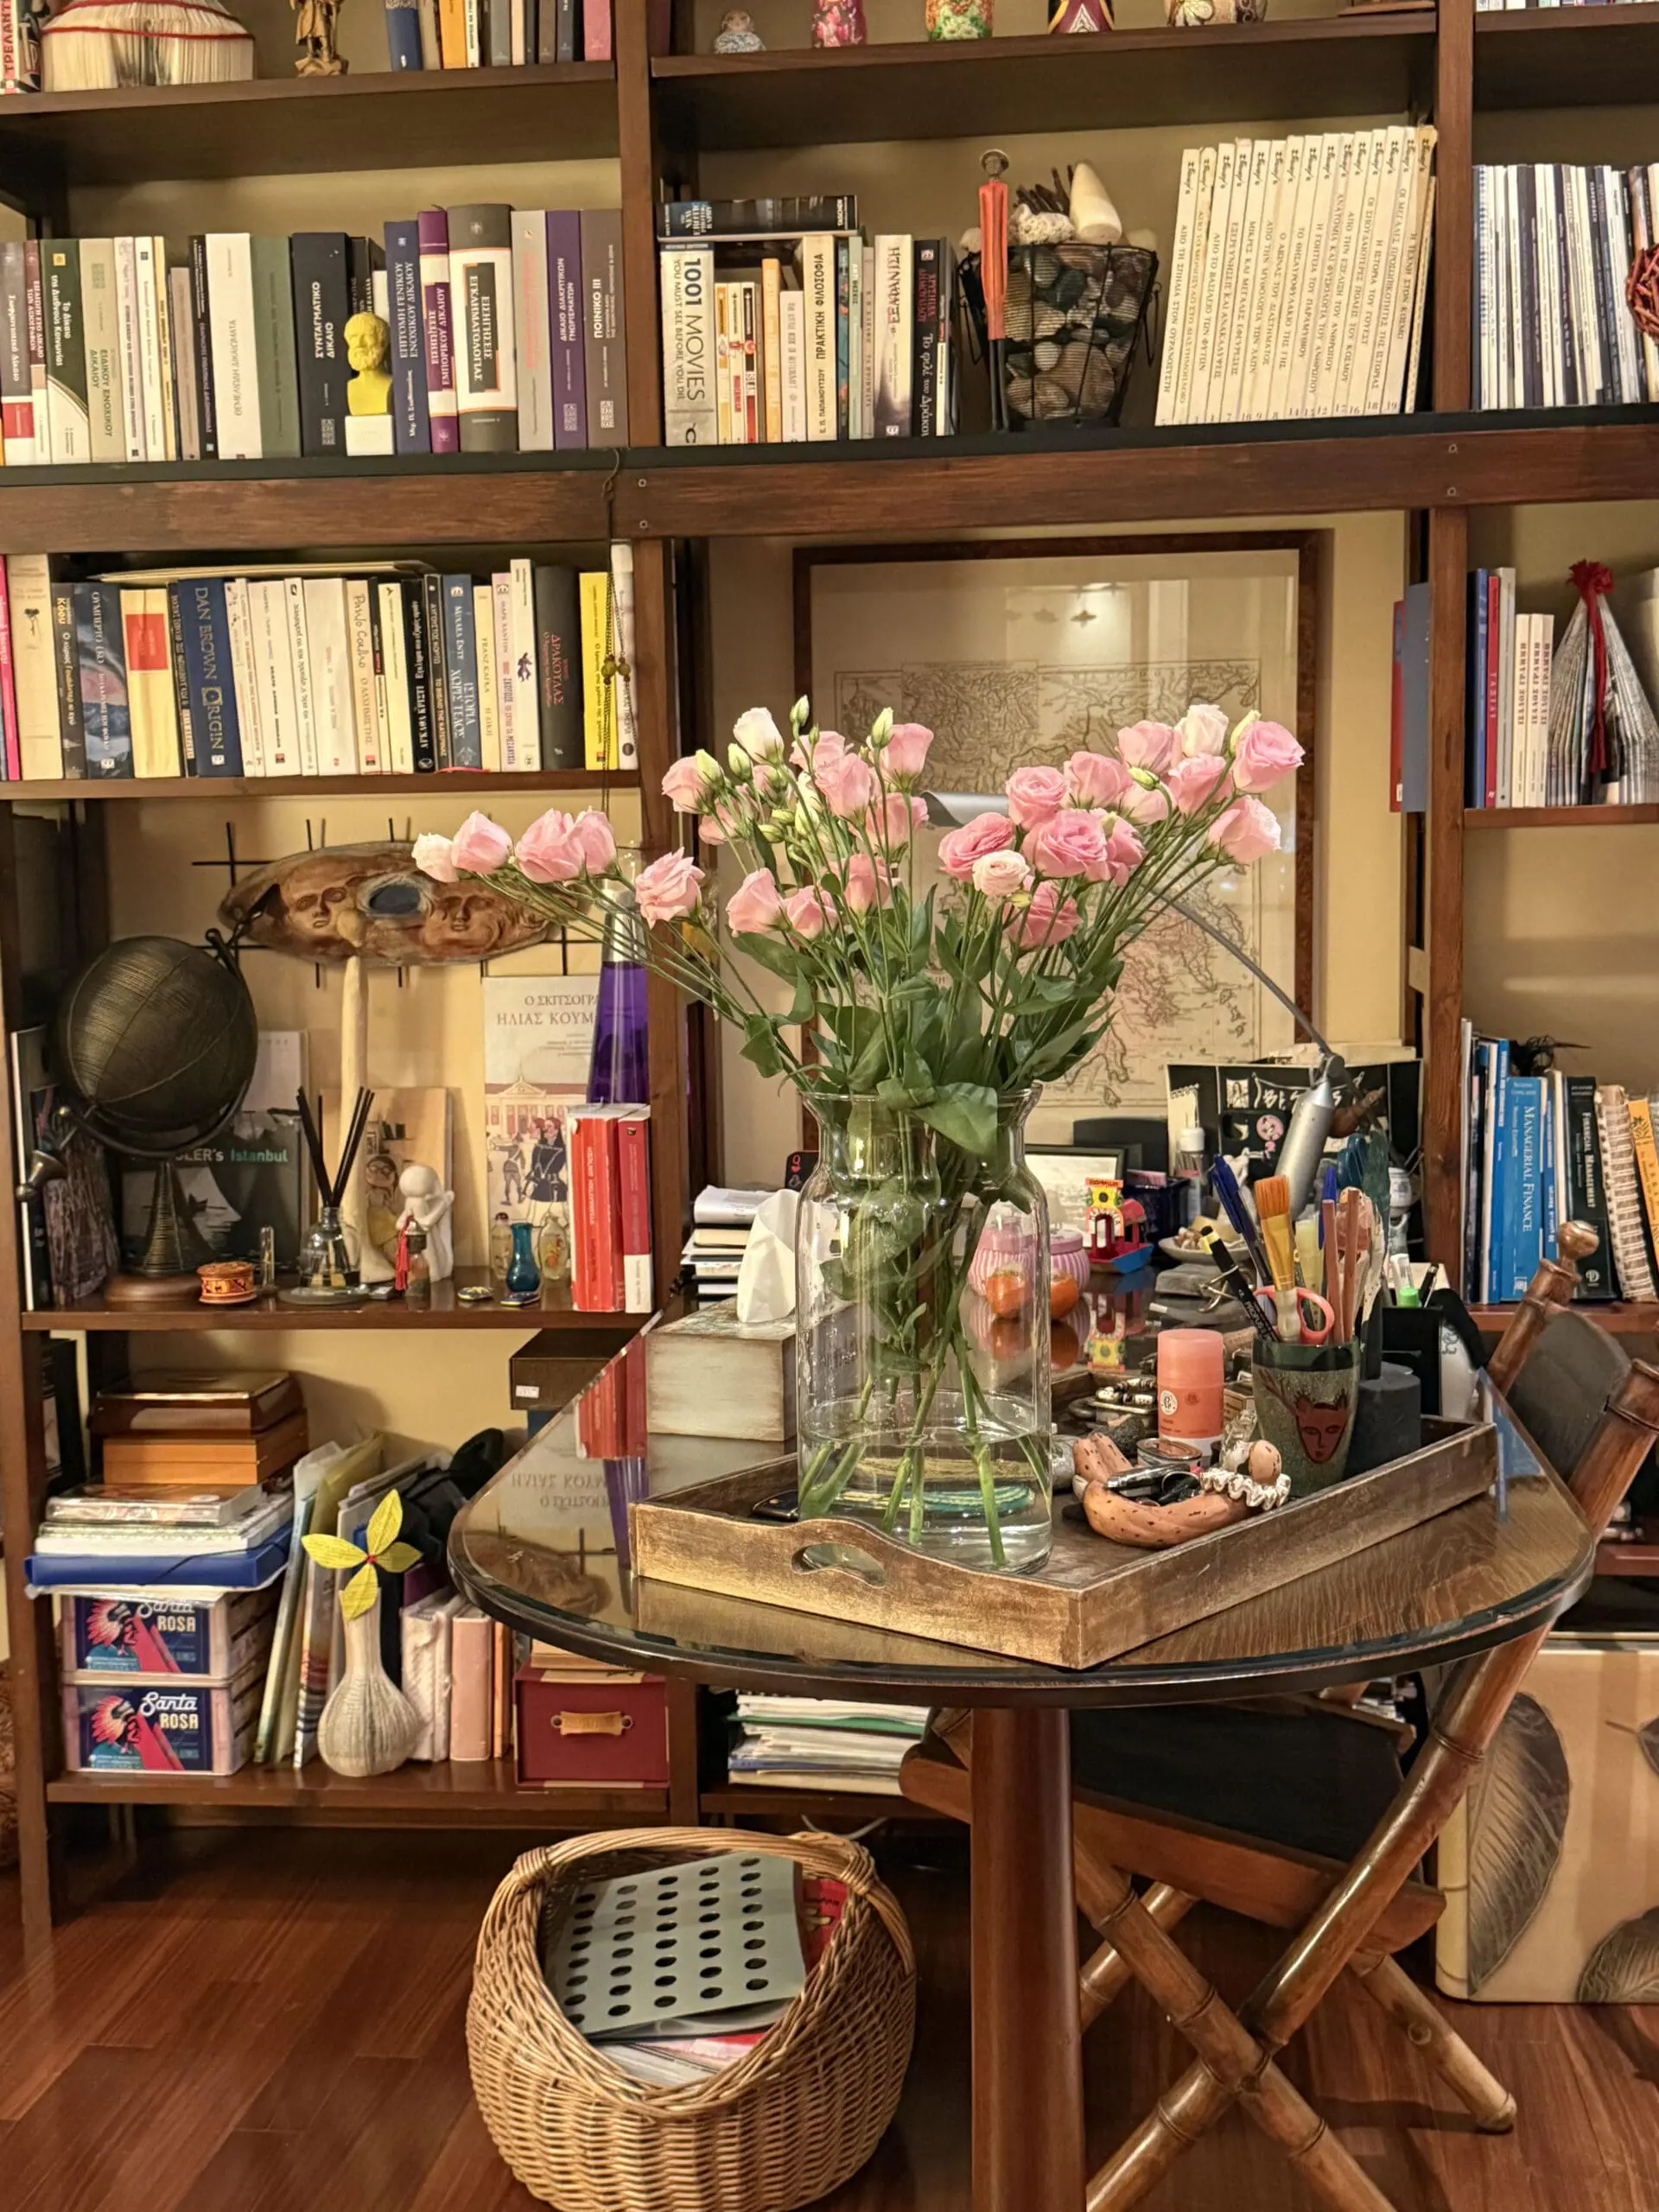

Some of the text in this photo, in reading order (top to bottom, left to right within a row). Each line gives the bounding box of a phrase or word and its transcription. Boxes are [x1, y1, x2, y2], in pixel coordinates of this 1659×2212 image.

[1, 0, 15, 73] ΤΡΕΛΑΝΤ
[1331, 194, 1343, 241] ΑΝΑΤΟΜΙΑ
[1345, 212, 1355, 232] ΑΠΟ
[1392, 200, 1404, 244] ΜΕΓΑΛΕΣ
[1246, 221, 1255, 254] ΜΙΚΡΕΣ
[1343, 236, 1351, 254] ΤΗΝ
[814, 253, 823, 306] ΦΙΛΟΣΟΦΙΑ
[1370, 251, 1382, 284] ΙΣΤΟΡΙΑ
[1406, 245, 1415, 275] ΤΕΧΝΗ
[557, 257, 568, 341] ΔΙΚΑΙΟ ΔΙΑΚΡΙΤΙΚΩΝ
[674, 283, 683, 307] MUST
[887, 246, 900, 324] ΕΞΑΦΑΝΙΣΗ
[1174, 264, 1183, 296] ΣΠΗΛΙΑ
[1205, 272, 1216, 313] ΒΑΣΙΛΕΙΟ
[1238, 278, 1249, 321] ΜΕΓΑΛΕΣ
[1255, 268, 1268, 321] ΜΥΘΟΛΟΓΙΑ
[1307, 277, 1316, 295] ΤΟΥ
[1367, 289, 1376, 307] ΤΟΥ
[1402, 278, 1411, 301] ΣΤΟΝ
[50, 275, 64, 365] της Διεθνούς Κοινωνίας
[62, 302, 72, 339] Το Δίκαιο
[312, 282, 323, 359] ΣΥΝΤΑΓΜΑΤΙΚΟ
[395, 263, 408, 359] ΕΠΙΤΟΜΗ ΓΕΝΙΚΟΥ
[405, 262, 418, 358] ΕΝΟΧΙΚΟΥ ΔΙΚΑΙΟΥ
[567, 282, 575, 341] ΓΝΩΡΙΣΜΑΤΩΝ
[593, 291, 603, 339] ΠΟΙΝΙΚΟ
[1171, 302, 1179, 324] ΣΤΟΝ
[1333, 301, 1342, 317] ΤΟΥ
[1351, 286, 1362, 319] ΠΟΛΕΙΣ
[325, 322, 335, 359] ΔΙΚΑΙΟ
[429, 310, 439, 365] ΕΙΣΗΓΗΣΕΙΣ
[436, 288, 450, 385] ΕΜΠΟΡΙΚΟΥ ΔΙΚΑΙΟΥ
[471, 276, 482, 382] ΕΓΚΛΗΜΑΤΟΛΟΓΙΑΣ
[482, 296, 492, 359] ΕΙΣΗΓΗΣΕΙΣ
[684, 258, 705, 400] 1001 MOVIES
[815, 312, 826, 359] ΠΡΑΚΤΙΚΗ
[922, 334, 933, 348] Το
[1203, 316, 1211, 335] ΤΩΝ
[1253, 327, 1262, 345] ΤΩΝ
[1262, 303, 1277, 365] ΔΙΑΣΤΗΜΑΤΟΣ
[1282, 331, 1291, 346] ΤΗΣ
[1299, 298, 1313, 359] ΠΑΡΑΜΥΘΙΟΥ
[1317, 323, 1325, 340] ΤΟΥ
[1362, 312, 1372, 346] ΓΟΥΕΣΤ
[920, 352, 934, 376] φιλί
[1164, 328, 1177, 392] ΟΥΡΑΝΟΞΥΣΤΗ
[1199, 339, 1209, 372] ΦΥΤΩΝ
[1250, 348, 1259, 374] ΛΑΩΝ
[1280, 351, 1288, 370] ΓΗΣ
[1325, 321, 1338, 372] ΑΝΘΡΩΠΟΥ
[1341, 345, 1353, 383] ΚΟΣΜΟΥ
[11, 355, 21, 381] Δίκαιο
[90, 349, 99, 388] ΔΙΚΑΙΟΥ
[229, 320, 243, 416] ΘΕΜΕΛΙΩΔΗ ΔΙΚΑΙΩΜΑΤΑ
[1310, 346, 1322, 395] ΑΝΘΡΩΠΟΥ
[1371, 351, 1382, 390] ΙΣΤΟΡΙΑΣ
[99, 349, 112, 436] ΕΙΔΙΚΟΥ ΕΝΟΧΙΚΟΥ
[817, 369, 826, 416] ΠΑΠΑΝΟΥΤΣΟΥ
[57, 597, 67, 625] Κόου
[91, 592, 104, 664] ΟΥΜΠΕΡΤΟ ΕΚΟ
[454, 607, 463, 638] ΜΙΧΑΕΛ
[353, 594, 368, 669] Paulo Coelho
[63, 641, 73, 664] κύριος
[194, 588, 224, 749] DAN BROWN ORIGIN
[550, 634, 563, 705] ΔΡΑΚΟΥΛΑΣ
[1541, 643, 1550, 685] ΓΡΑΜΜΗ
[361, 686, 372, 745] ΑΛΧΗΜΙΣΤΗΣ
[416, 686, 429, 749] ΑΓΚΑΘΑ ΚΡΙΣΤΙ
[435, 687, 444, 709] ΒΙΒΛΙΟ
[449, 669, 465, 739] ΧΩΡΙΣ ΤΕΛΟΣ
[463, 683, 475, 725] ΙΣΤΟΡΙΑ
[438, 723, 448, 758] ΚΑΤΕΡΙΝΑΣ
[497, 1012, 594, 1026] ΗΛΙΑΣ ΚΟΥΜ
[524, 995, 535, 1007] Ο
[175, 1147, 288, 1163] LER's Istanbul
[792, 1154, 801, 1166] Q
[1522, 1106, 1535, 1179] MANAGERIAL
[1581, 1112, 1595, 1208] FINANCIAL MANAGEMENT
[1522, 1183, 1535, 1231] FINANCE
[137, 1601, 195, 1618] Santa
[157, 1615, 196, 1632] ROSA
[140, 1691, 199, 1718] Santa
[159, 1713, 199, 1730] ROSA
